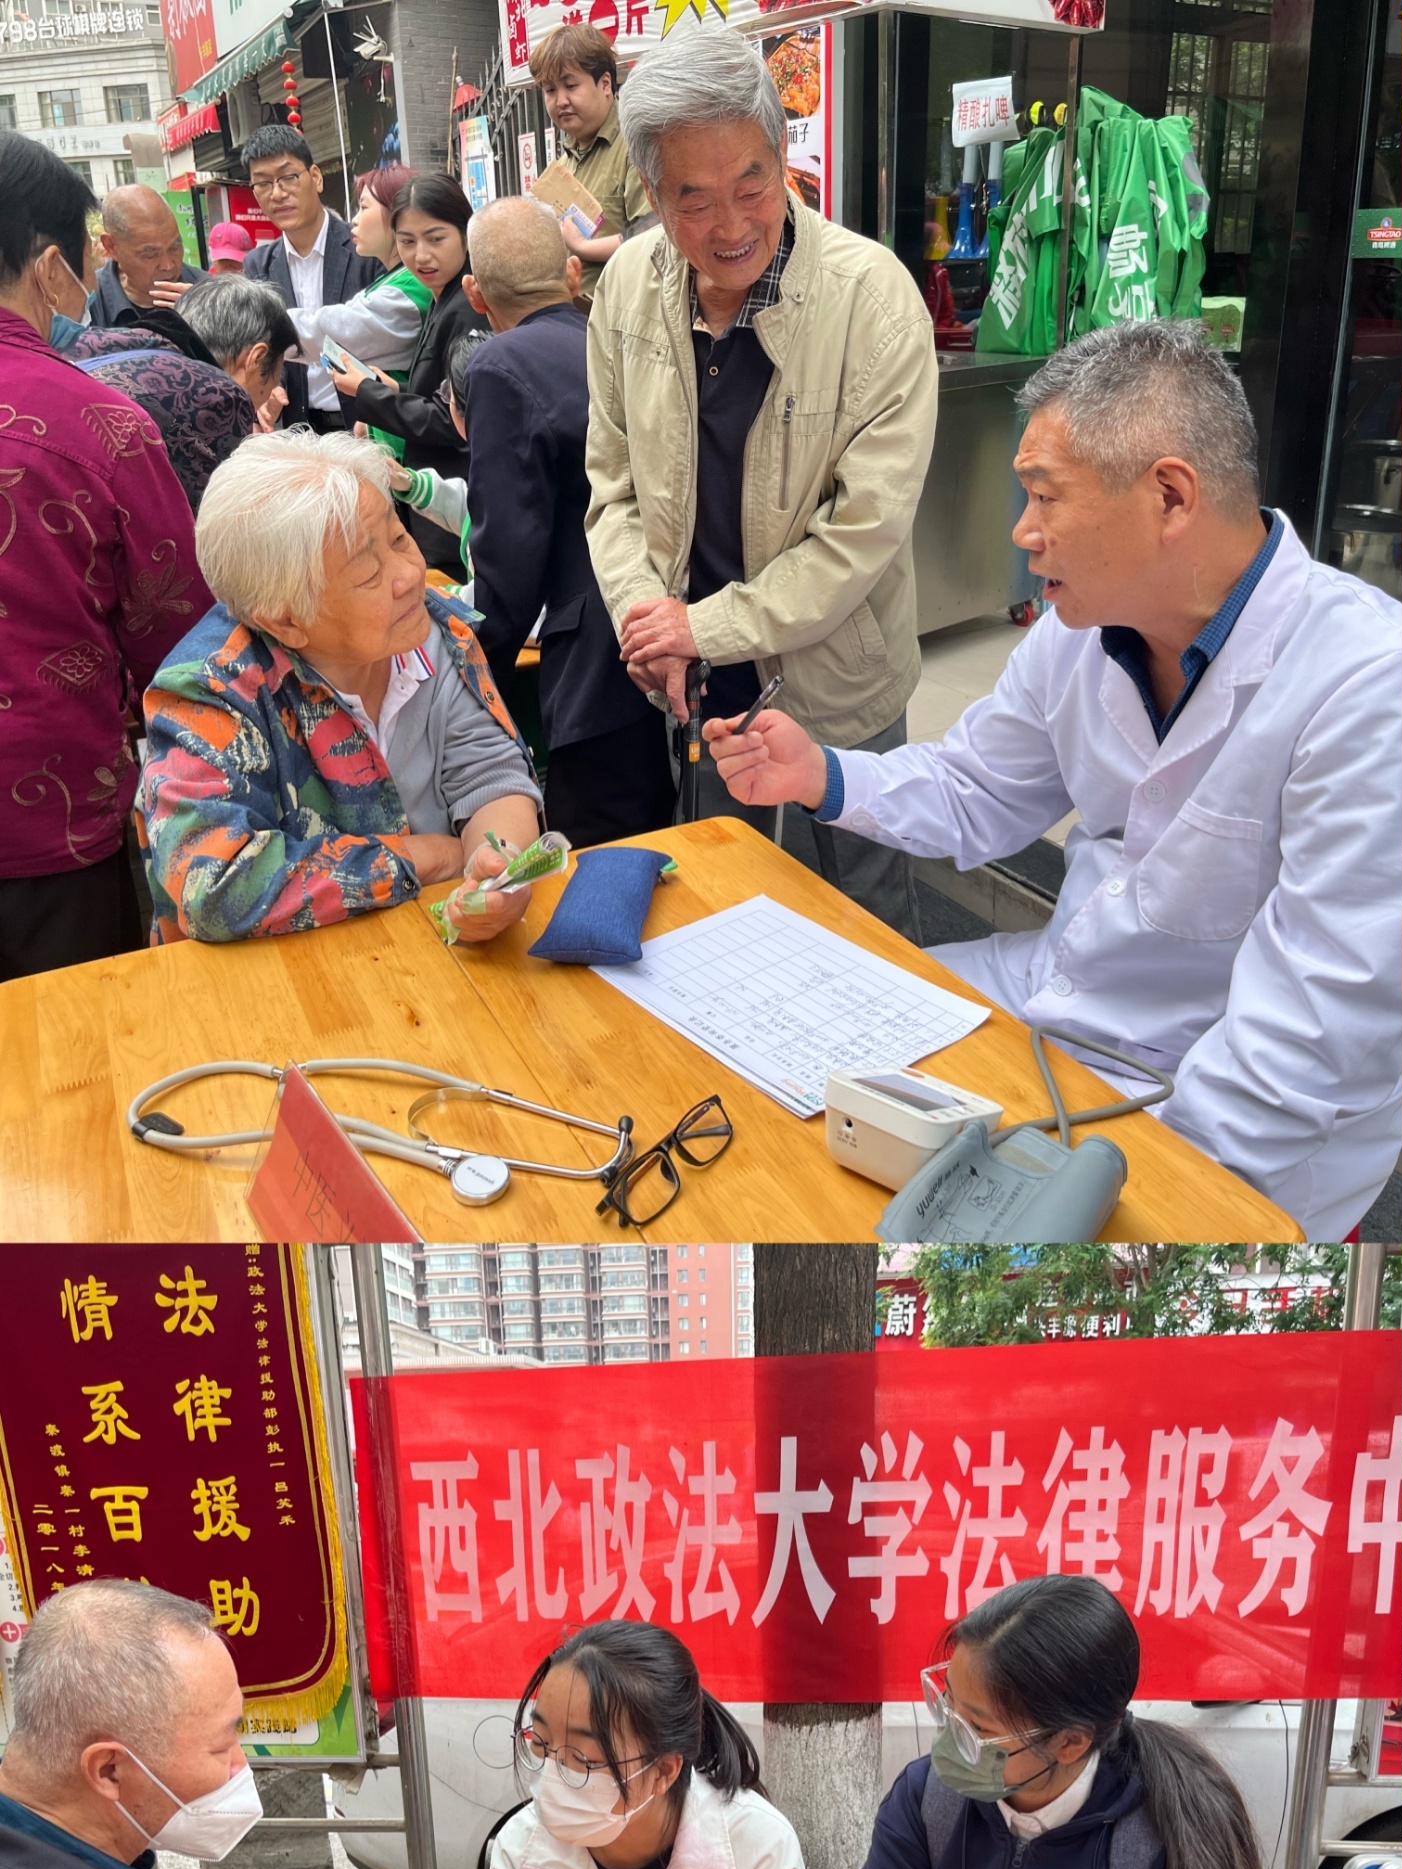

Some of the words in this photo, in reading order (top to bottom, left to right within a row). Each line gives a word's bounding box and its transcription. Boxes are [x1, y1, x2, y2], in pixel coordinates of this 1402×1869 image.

[957, 96, 1011, 132] 精酿扎啤
[1369, 230, 1402, 239] TSINGTAO
[915, 1172, 945, 1220] yuwell
[154, 1264, 261, 1637] 法律援助
